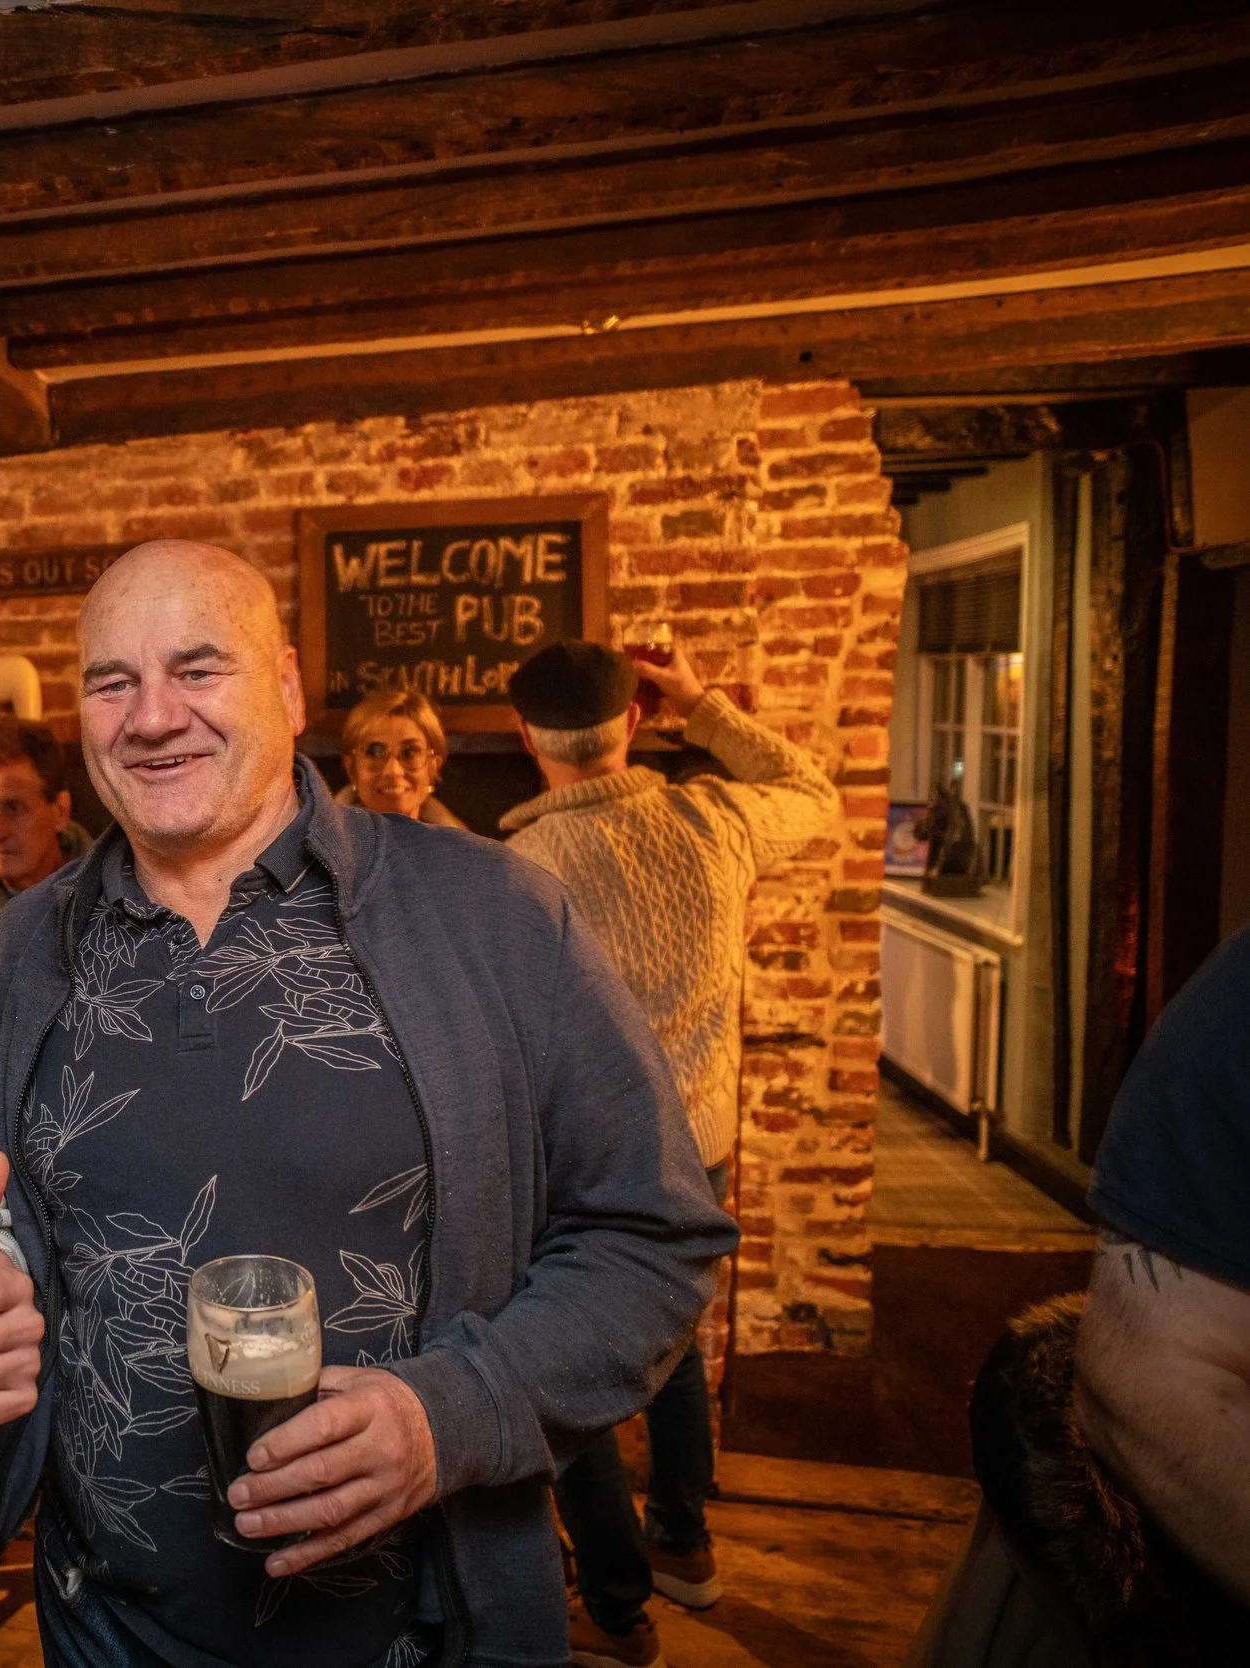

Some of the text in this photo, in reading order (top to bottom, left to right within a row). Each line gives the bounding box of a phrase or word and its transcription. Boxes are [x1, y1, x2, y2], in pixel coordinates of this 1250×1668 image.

[23, 557, 77, 584] OUT
[331, 533, 571, 592] WELCOME
[374, 618, 444, 648] BEST
[454, 593, 544, 645] PUB
[193, 1365, 261, 1395] UINNESS
